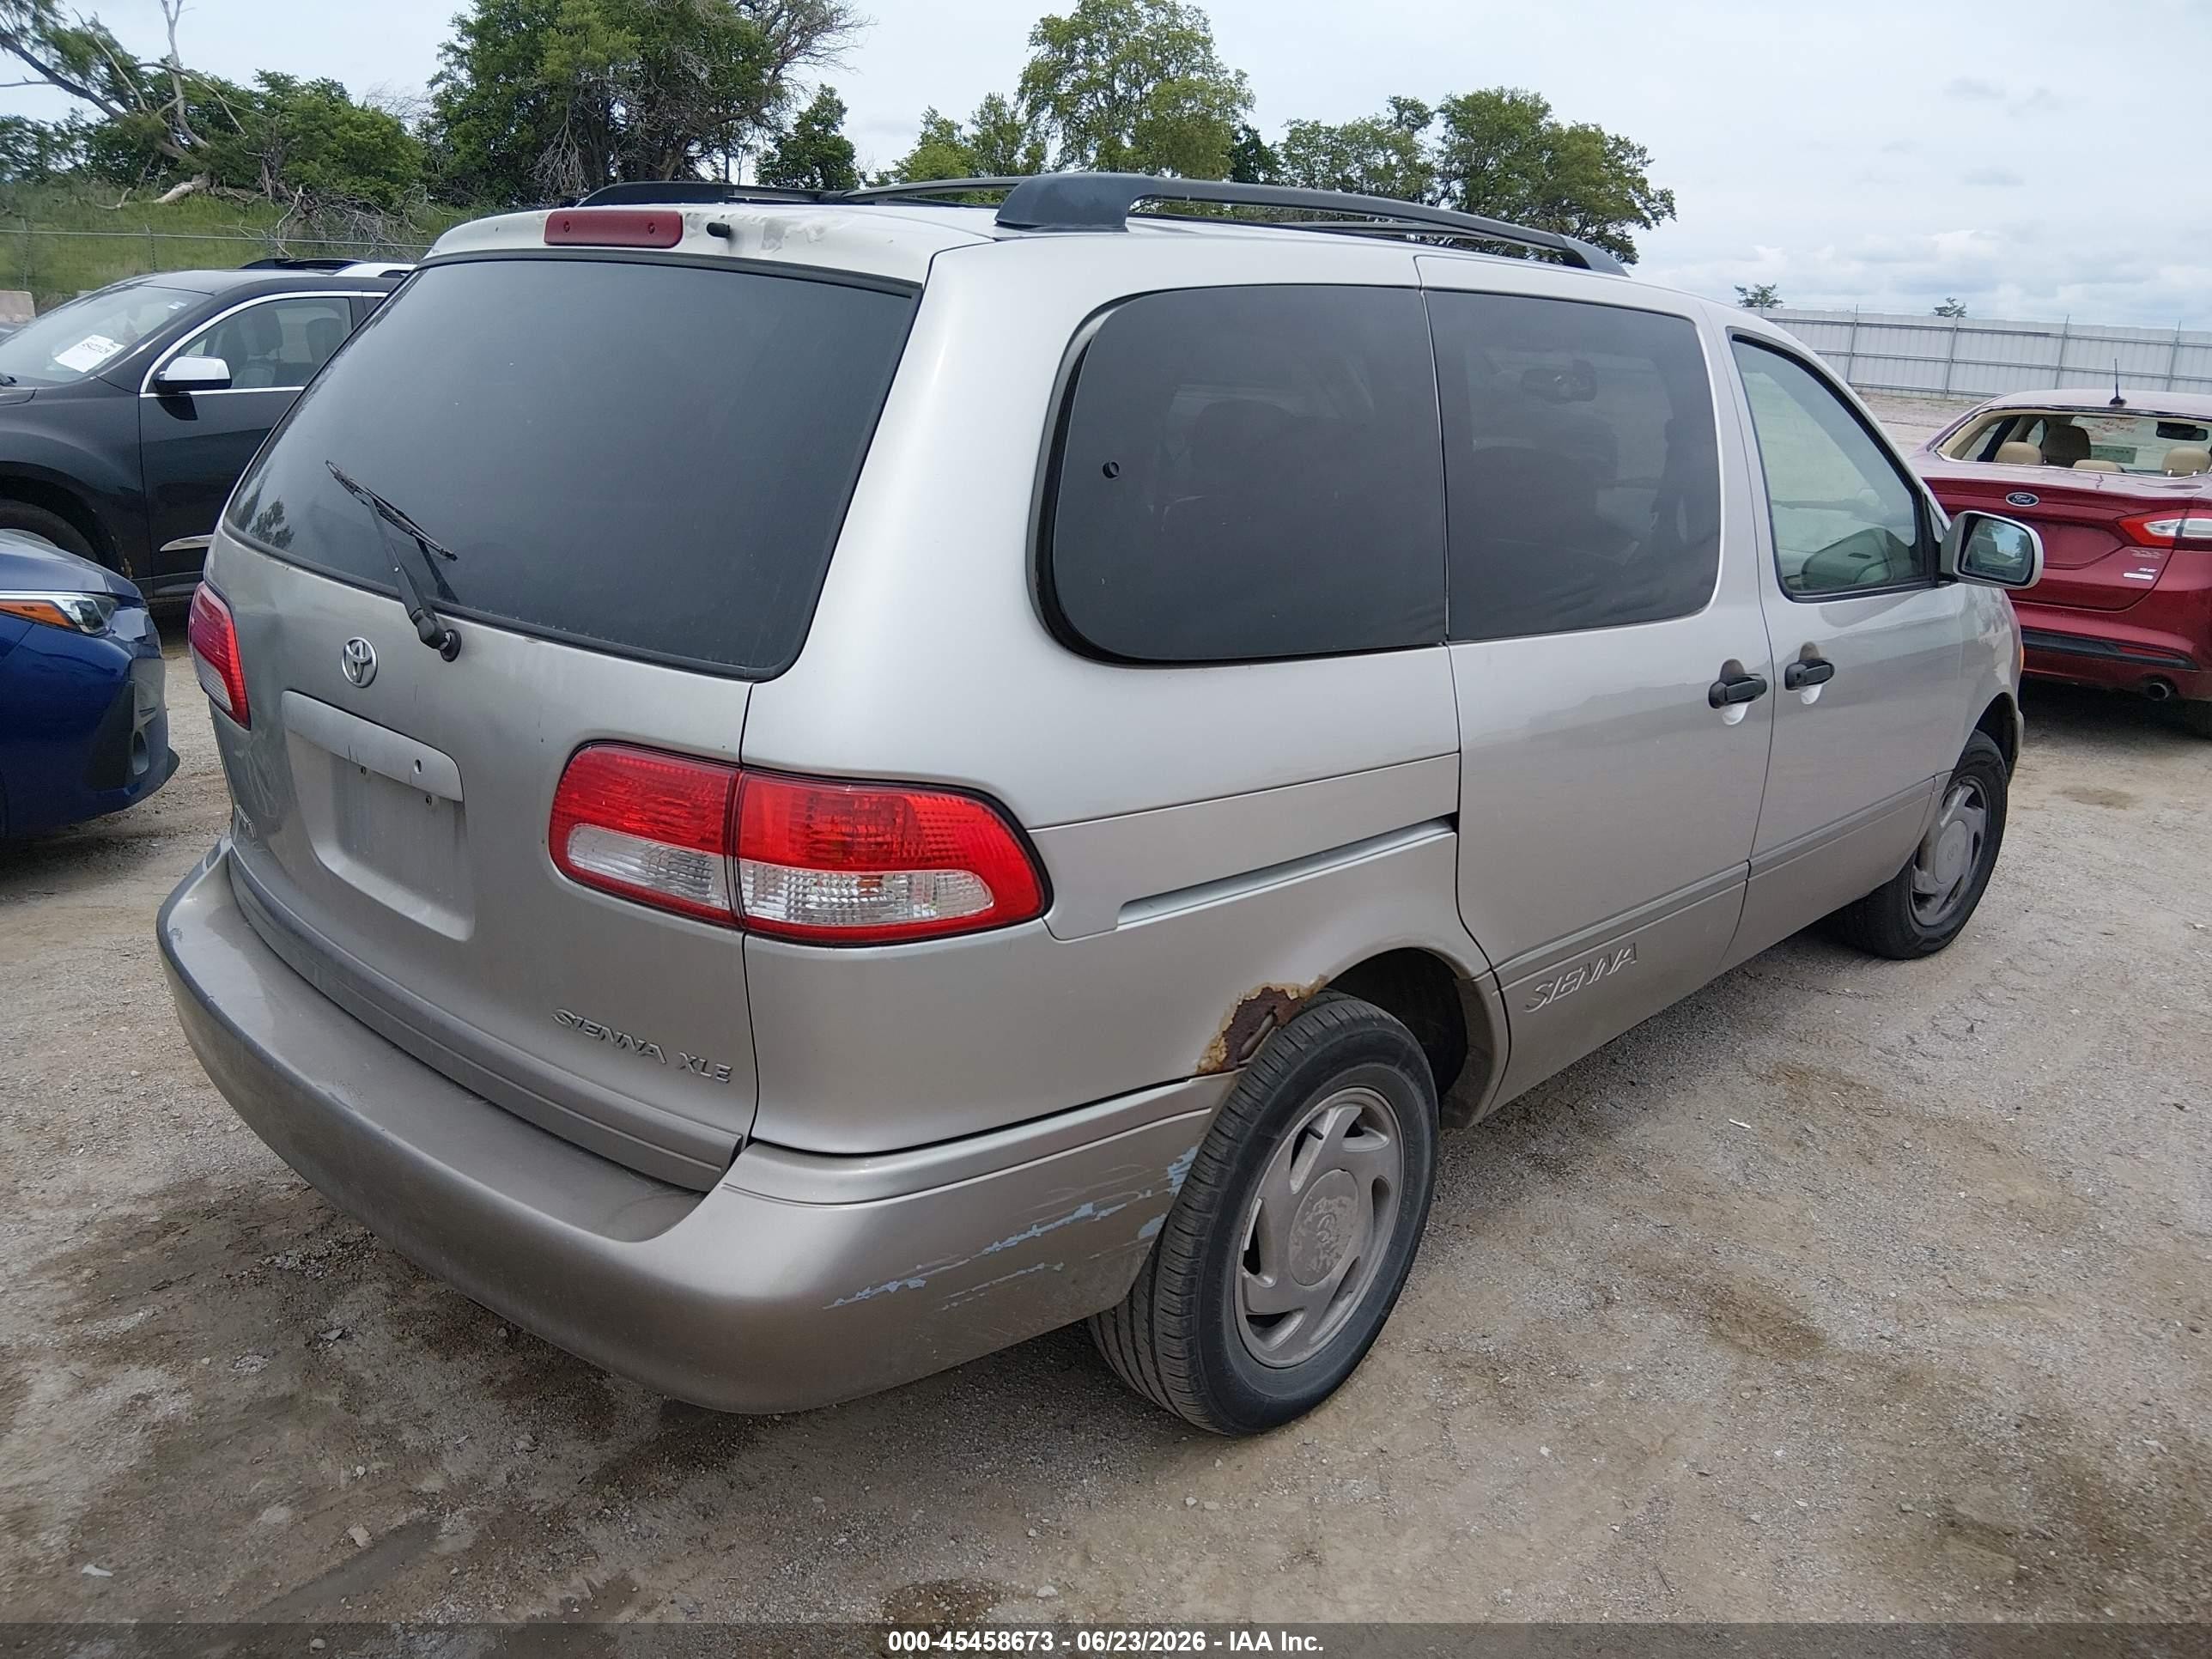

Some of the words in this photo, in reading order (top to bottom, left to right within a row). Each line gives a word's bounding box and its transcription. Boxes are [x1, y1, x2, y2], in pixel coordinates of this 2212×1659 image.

[2012, 495, 2033, 503] Ford
[1523, 942, 1638, 1013] SIENNA
[551, 1008, 667, 1065] SIENNA
[678, 1050, 732, 1084] XLE
